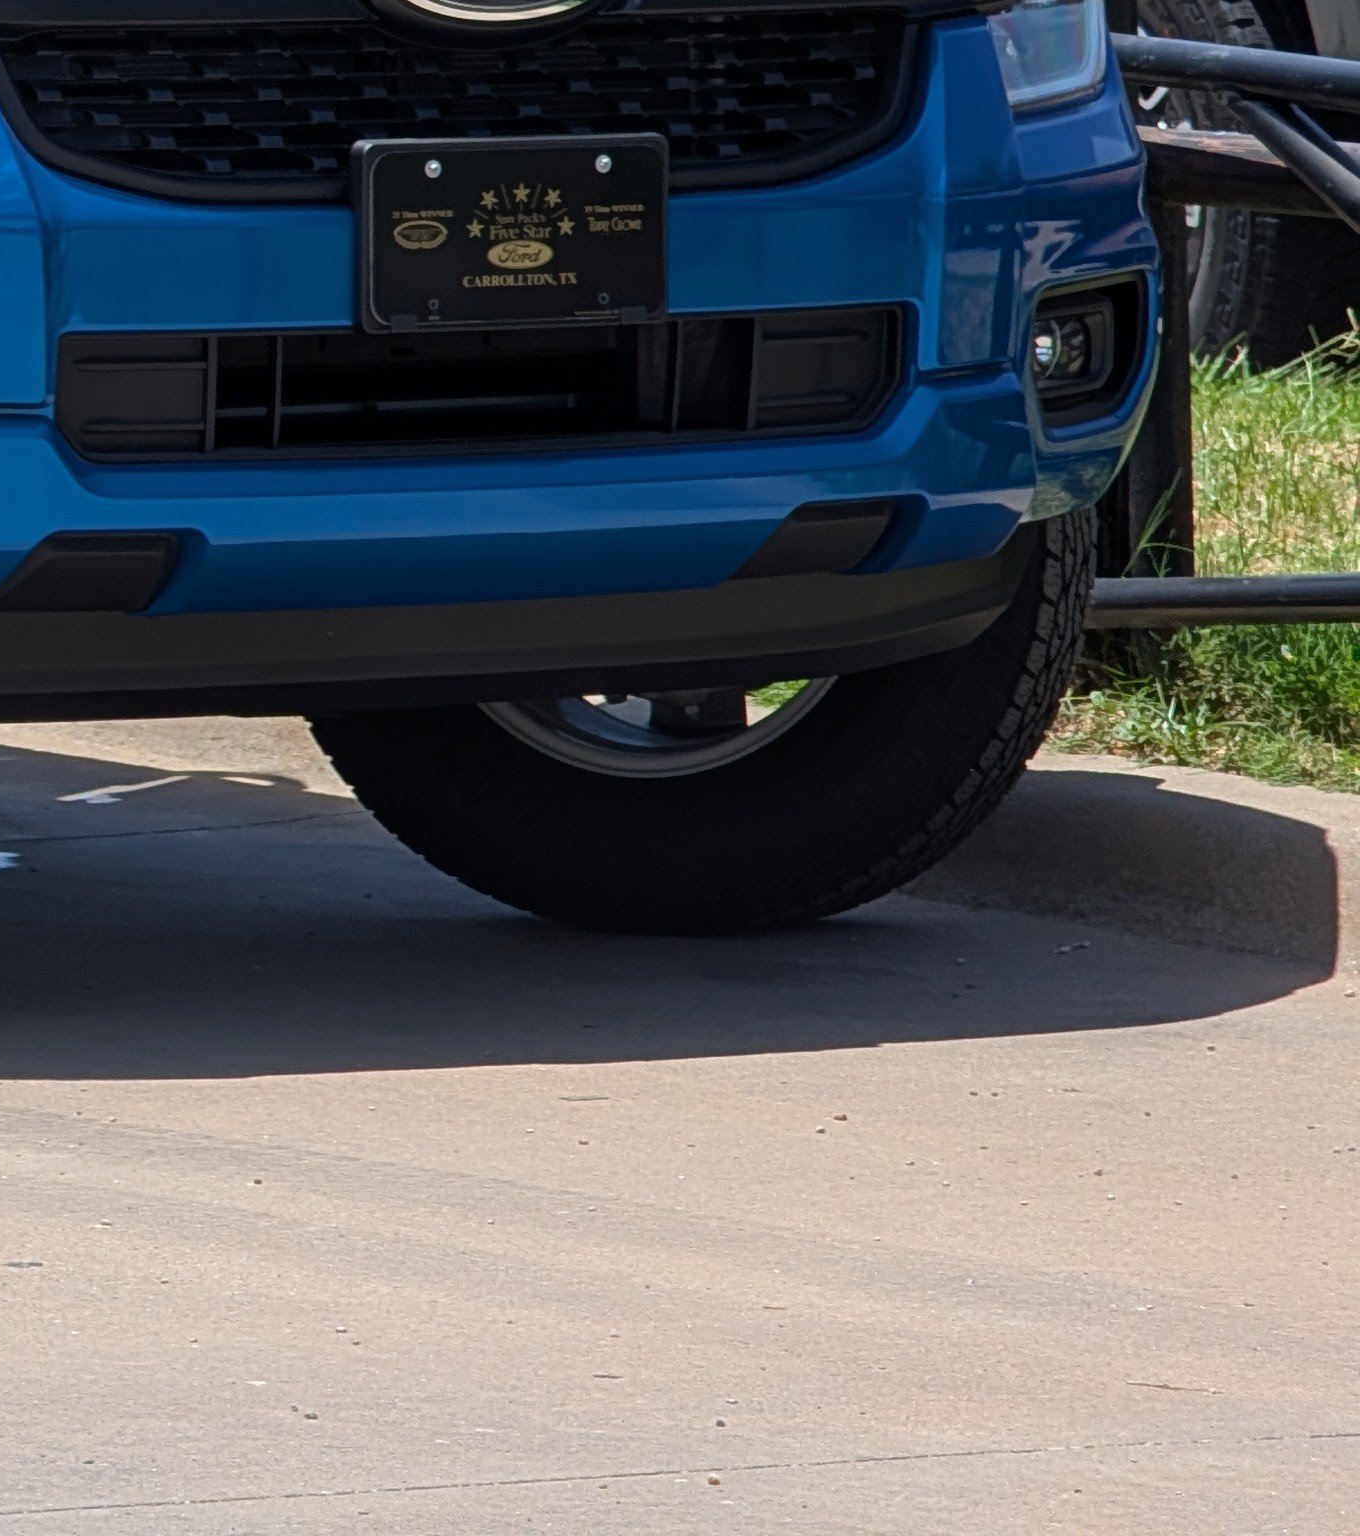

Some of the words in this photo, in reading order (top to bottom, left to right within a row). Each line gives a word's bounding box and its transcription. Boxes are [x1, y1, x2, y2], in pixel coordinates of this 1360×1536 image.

[488, 224, 520, 240] Five
[523, 224, 552, 239] Star
[498, 243, 542, 263] Ford
[558, 272, 578, 285] TX
